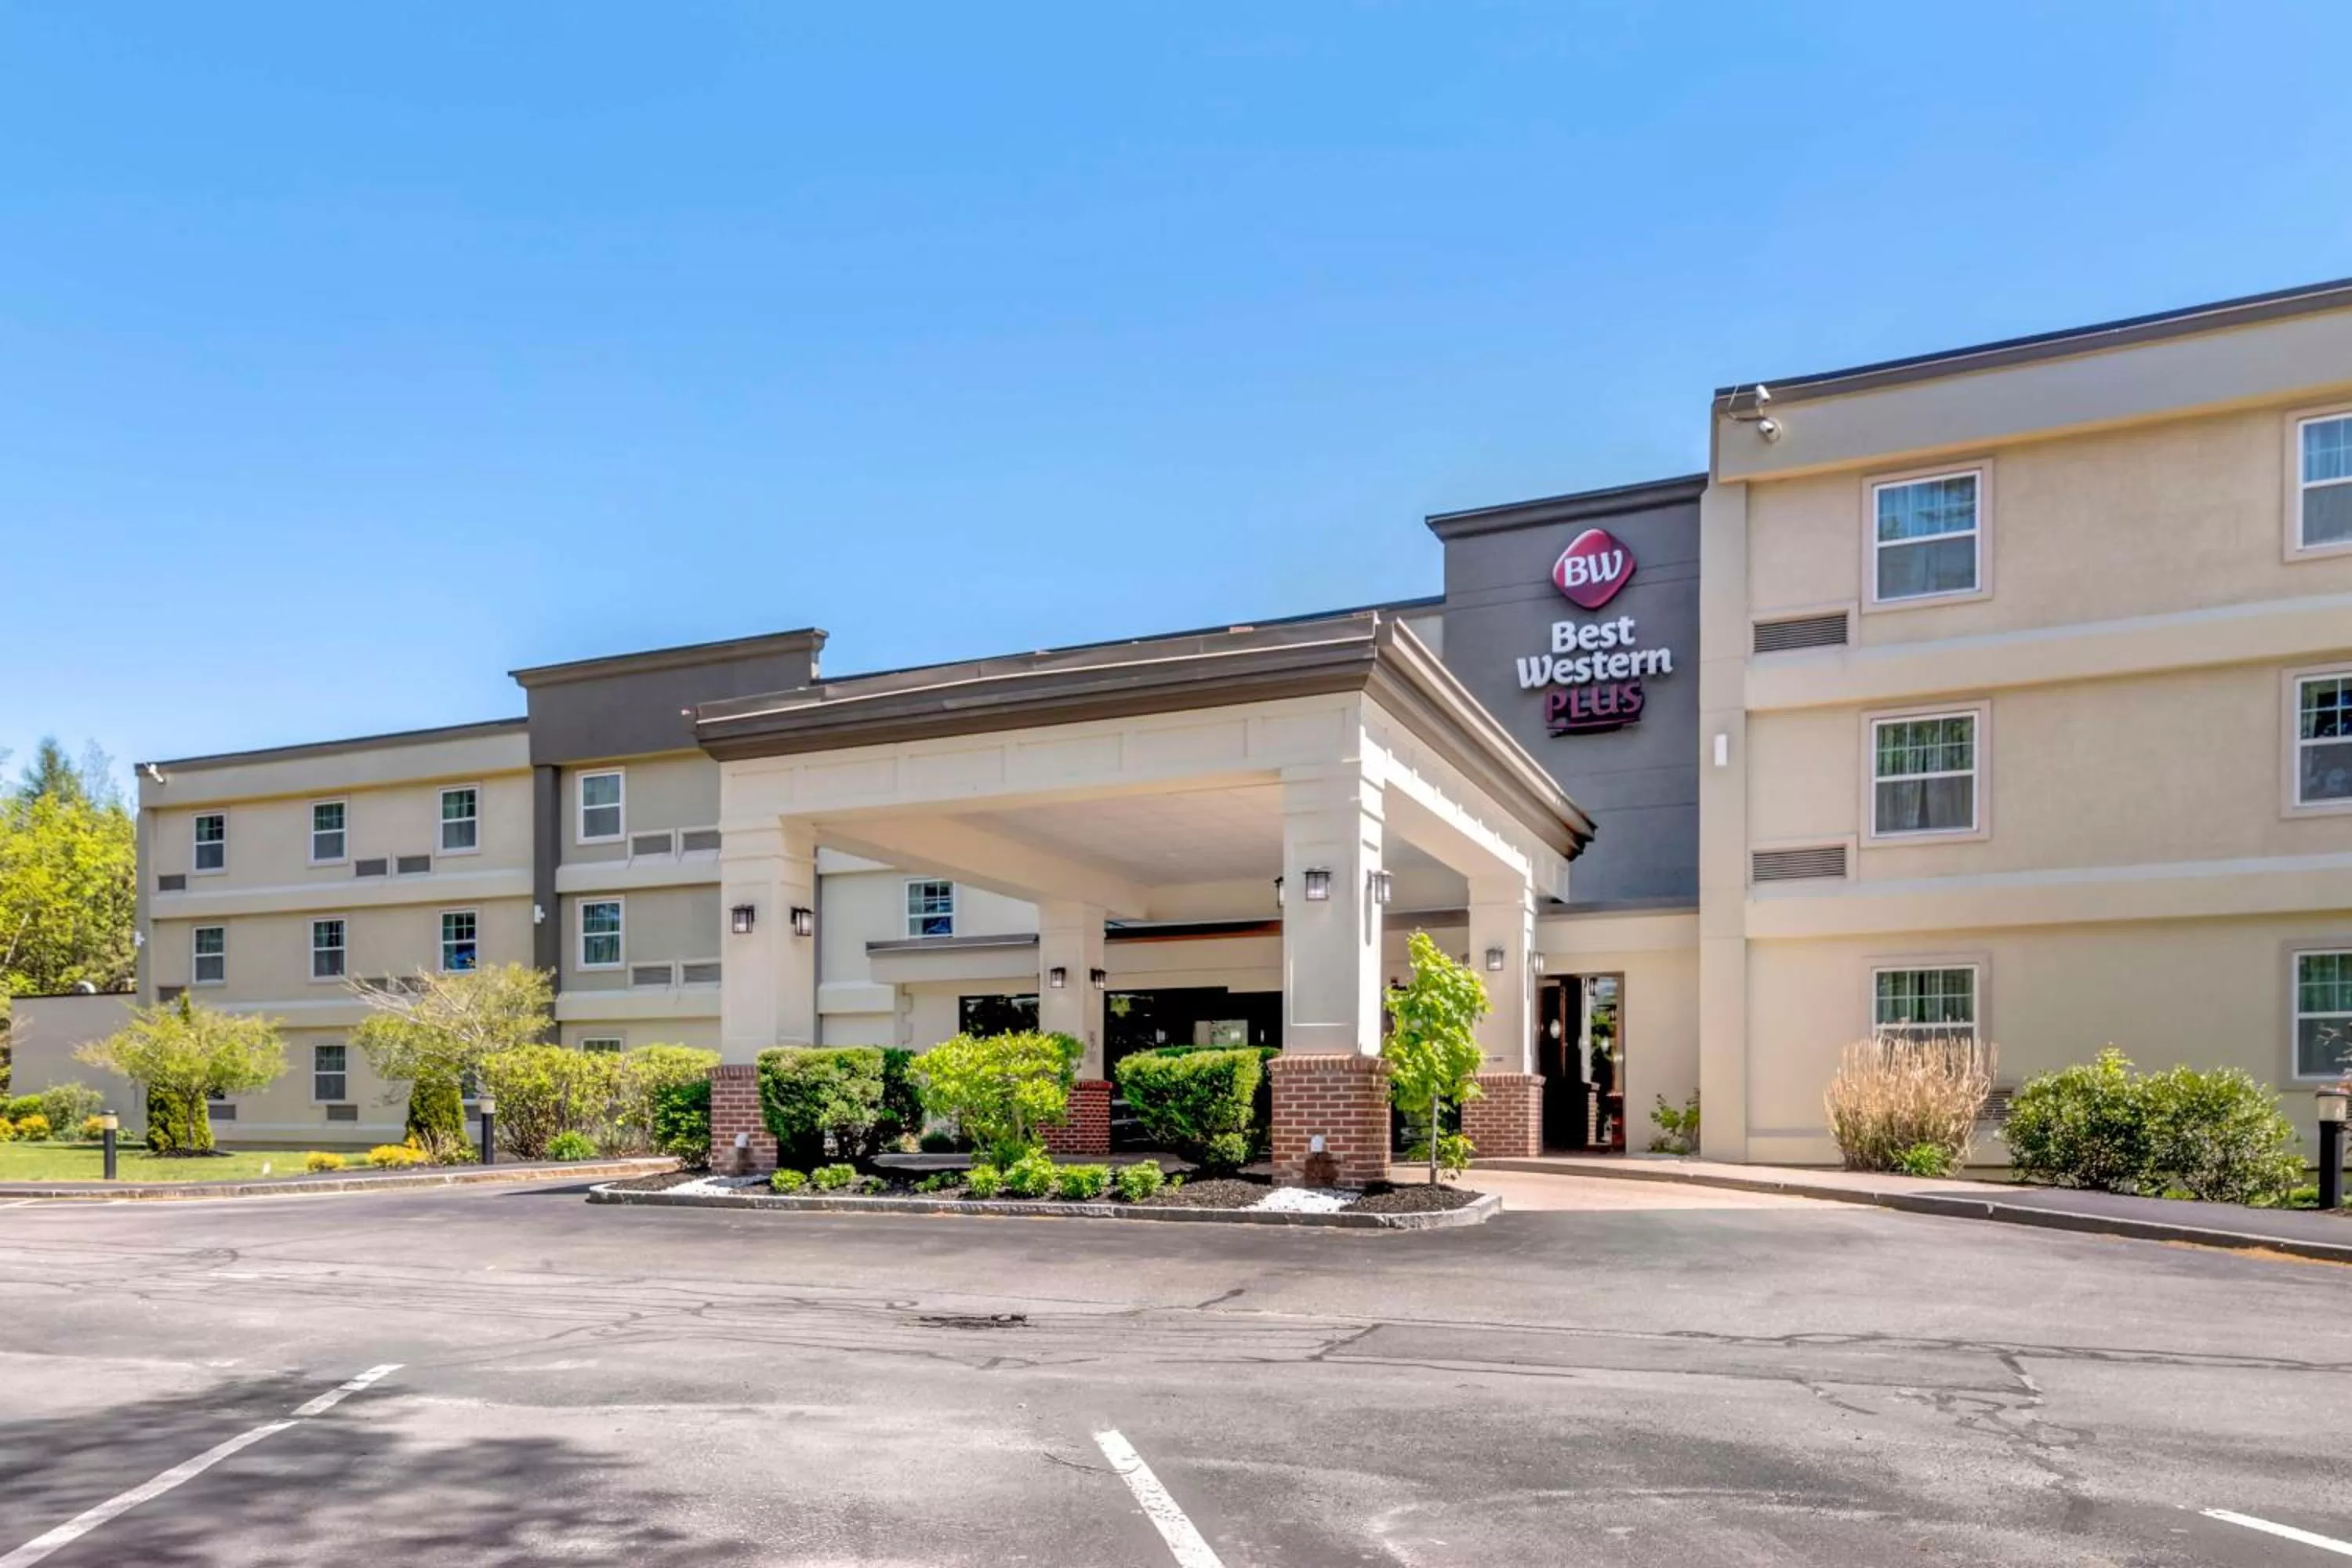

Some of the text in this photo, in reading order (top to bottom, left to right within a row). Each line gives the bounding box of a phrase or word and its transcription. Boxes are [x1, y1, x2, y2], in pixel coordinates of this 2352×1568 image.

[1564, 550, 1623, 586] BW
[1552, 615, 1636, 653] Best
[1516, 647, 1673, 688] Western
[1544, 681, 1644, 722] PLUS
